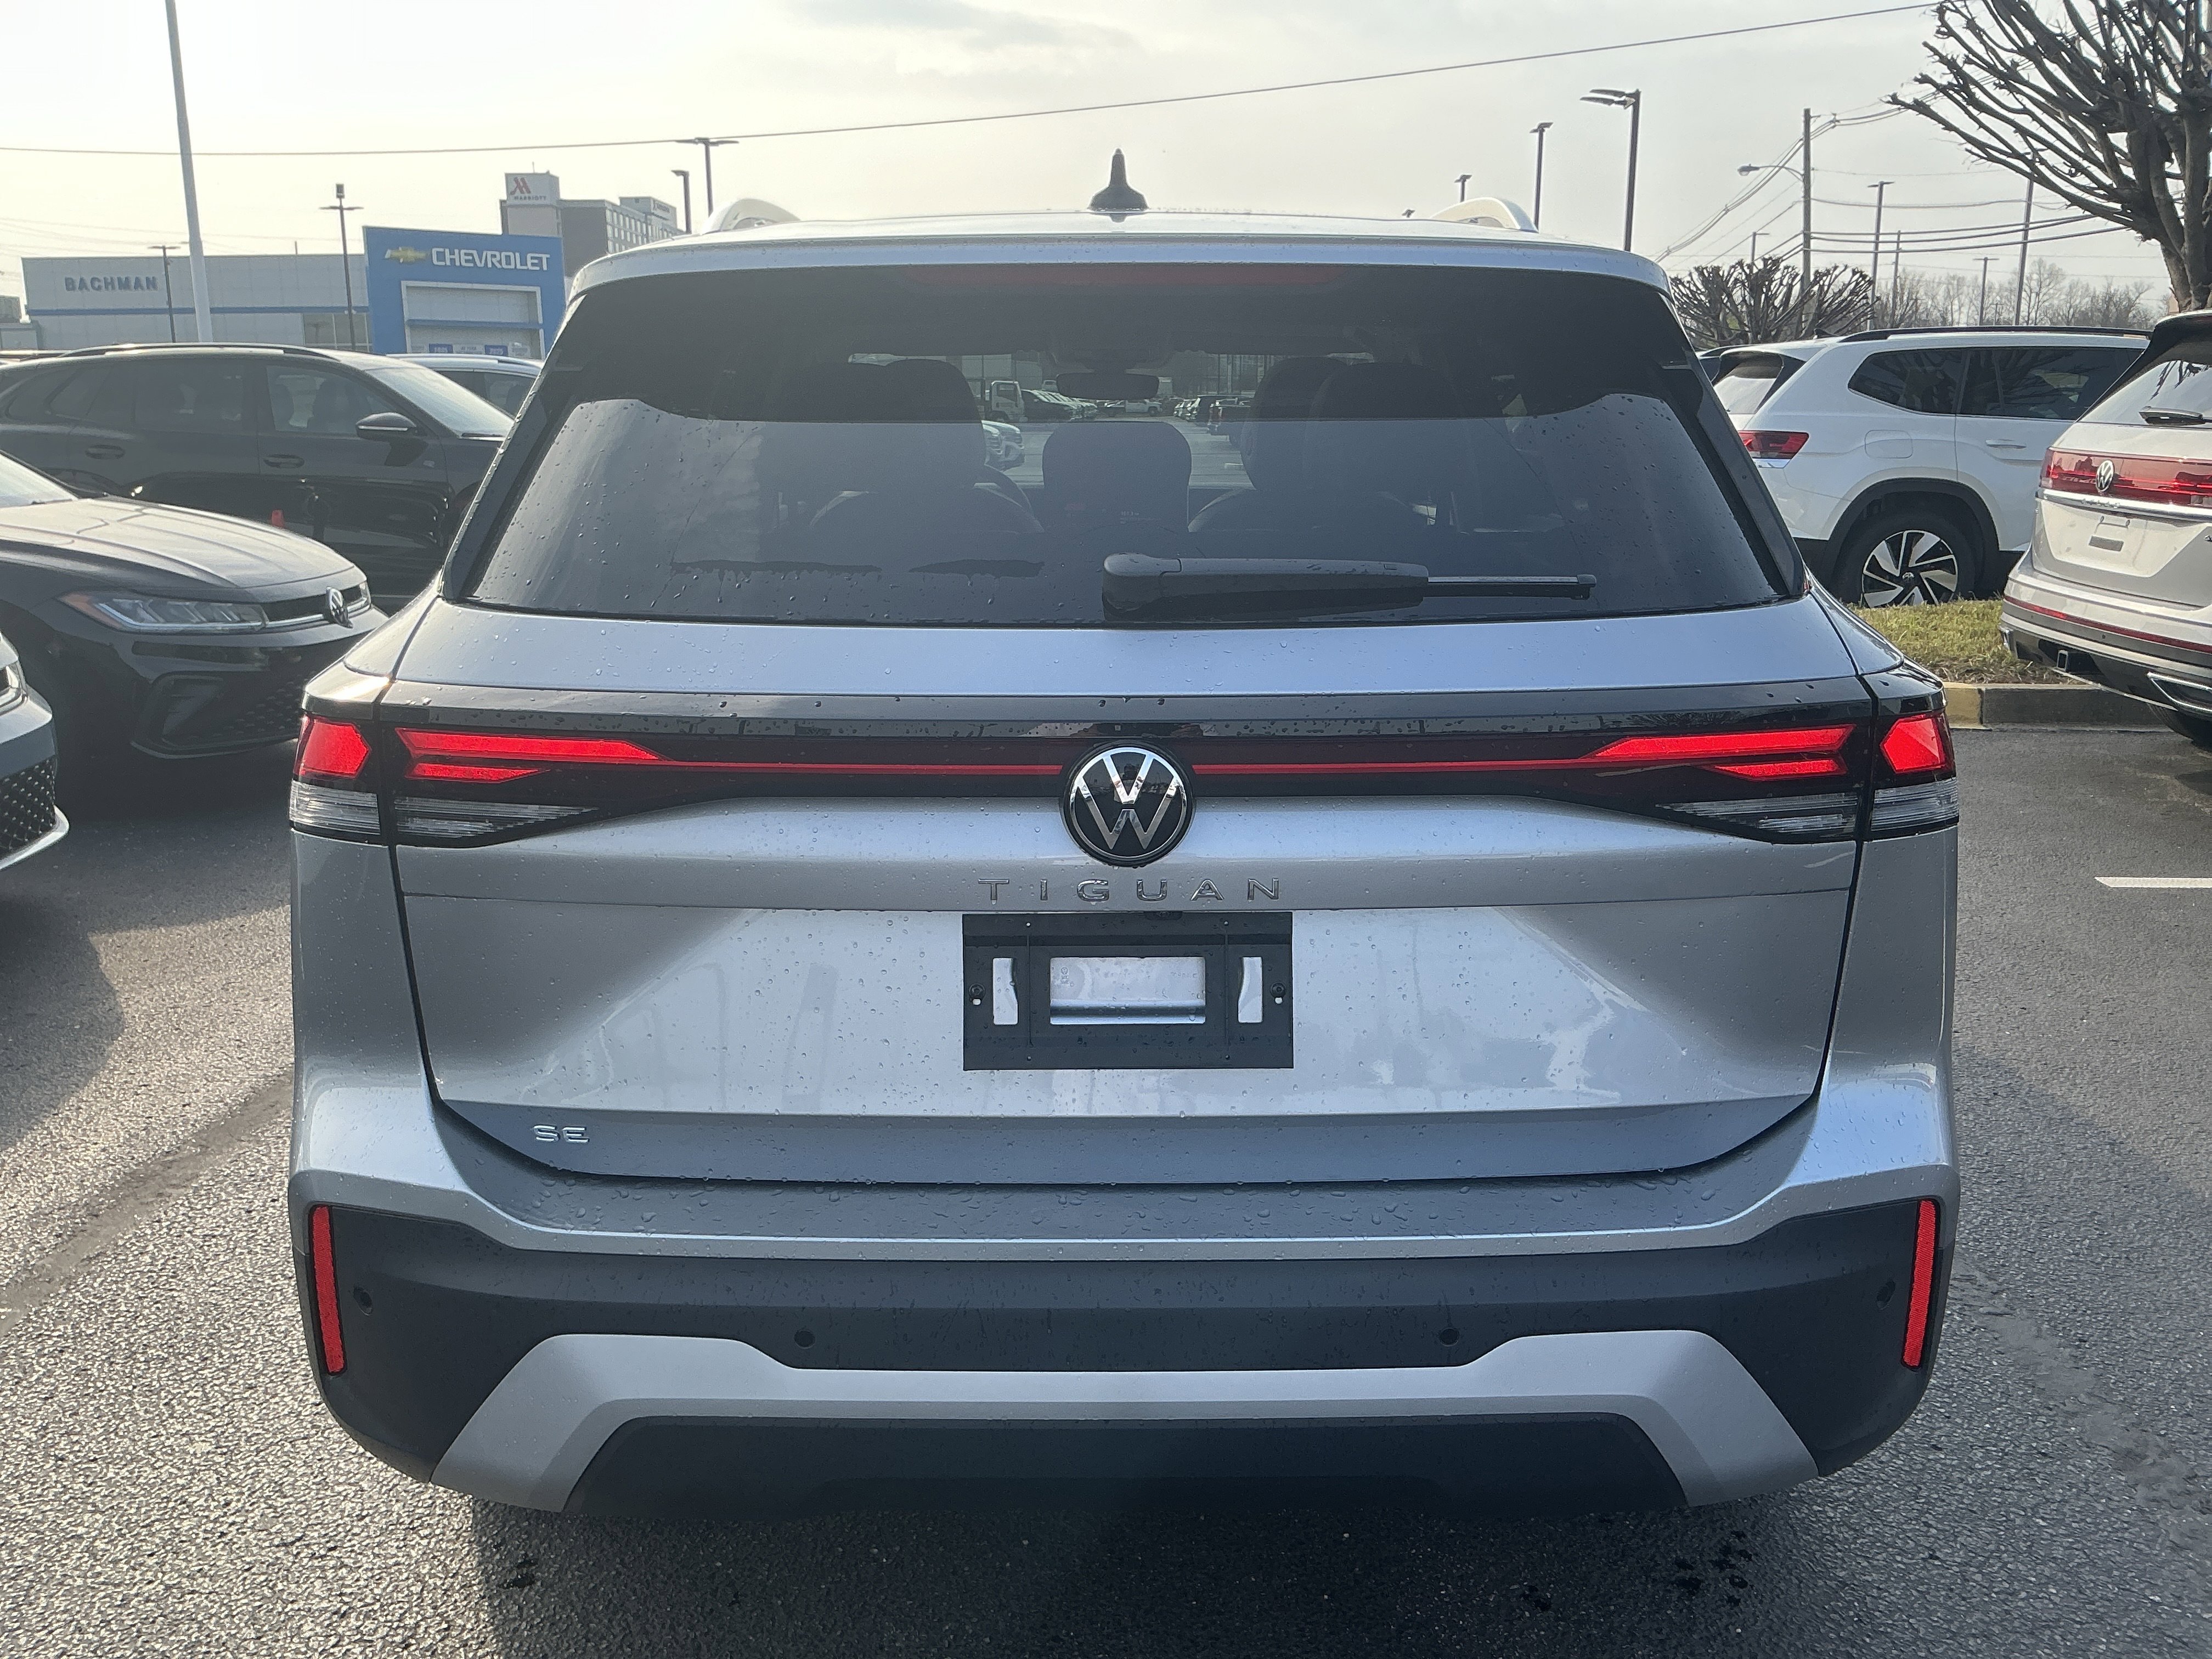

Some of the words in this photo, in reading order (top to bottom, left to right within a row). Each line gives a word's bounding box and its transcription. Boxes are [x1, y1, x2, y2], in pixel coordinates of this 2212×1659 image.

[432, 247, 550, 271] CHEVROLET
[64, 276, 159, 292] BACHMAN
[1070, 747, 1187, 857] VW
[978, 879, 1279, 901] TIGUAN
[533, 1124, 590, 1144] SE
